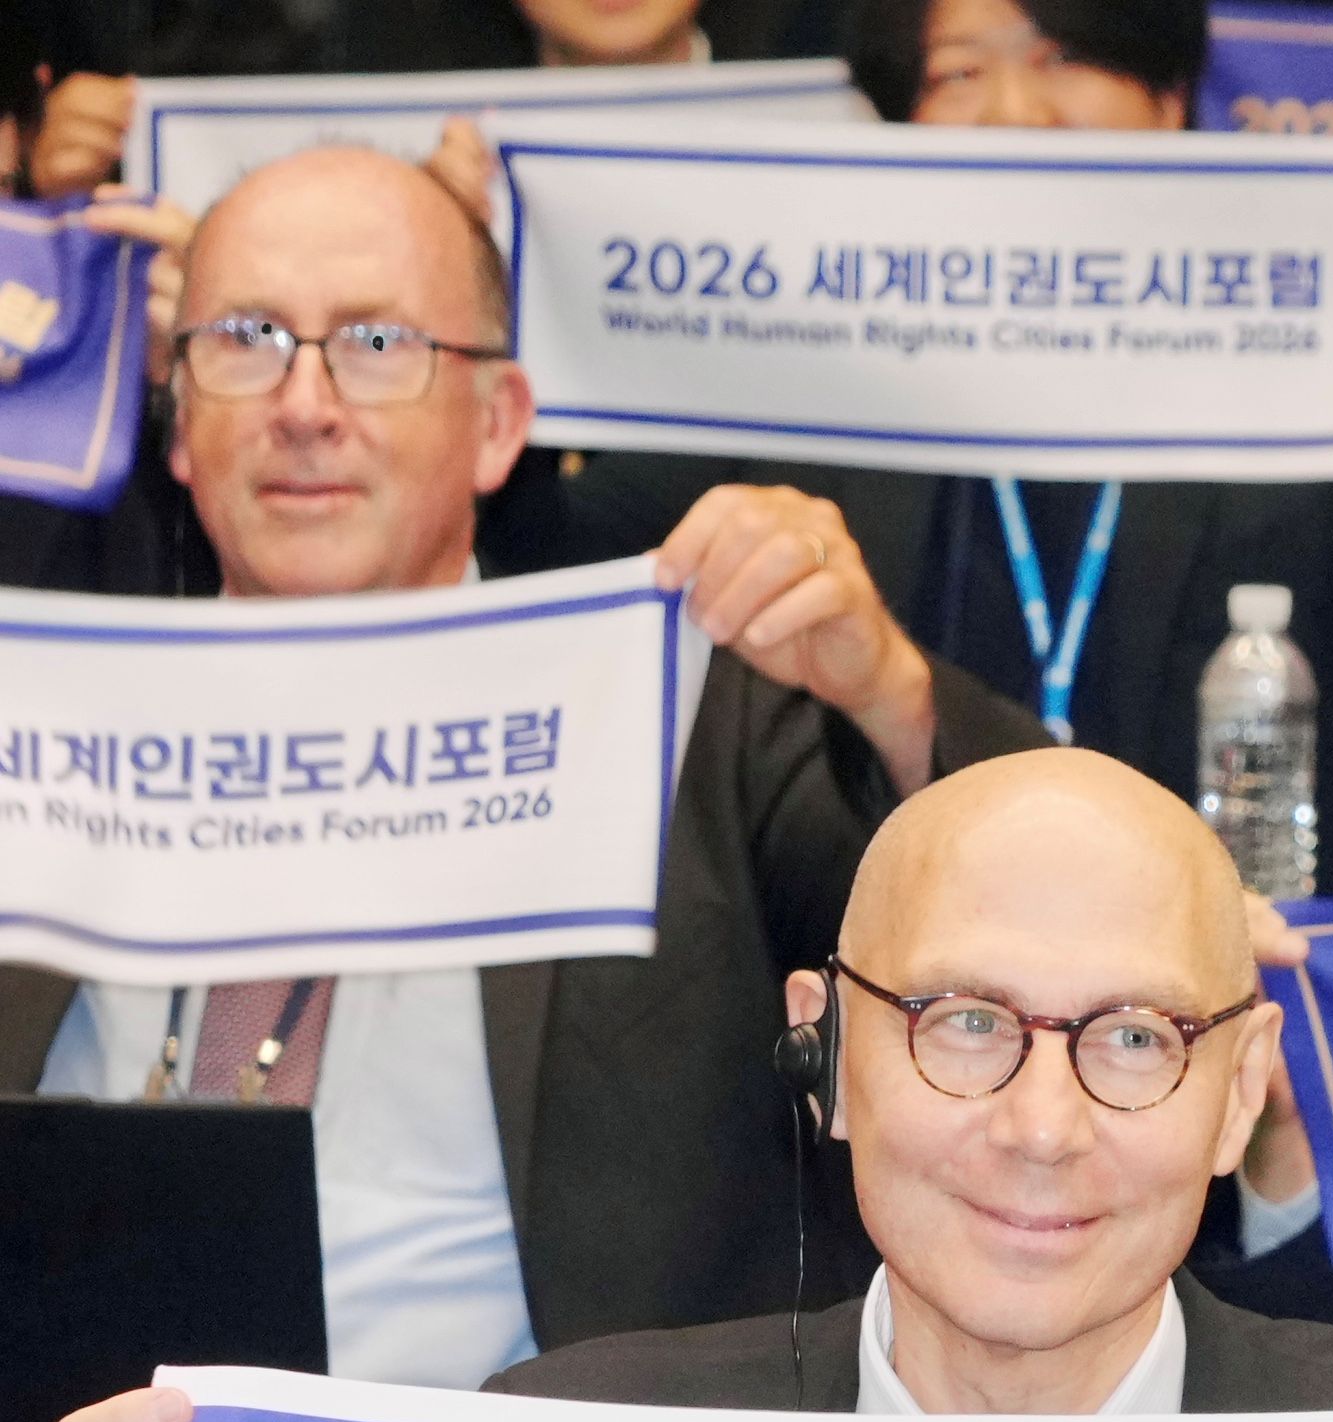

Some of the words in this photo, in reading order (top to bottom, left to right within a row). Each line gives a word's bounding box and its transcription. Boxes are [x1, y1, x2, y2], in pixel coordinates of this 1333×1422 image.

[604, 240, 779, 299] 2026
[806, 244, 1324, 309] 세계인권도시포럼
[602, 310, 710, 338] World
[720, 316, 852, 344] Human
[864, 319, 978, 354] Rights
[993, 322, 1092, 352] Cities
[1107, 322, 1223, 352] Forum
[45, 797, 174, 848] Rights
[187, 814, 304, 851] Cities
[321, 804, 449, 842] Forum
[462, 785, 553, 830] 2026
